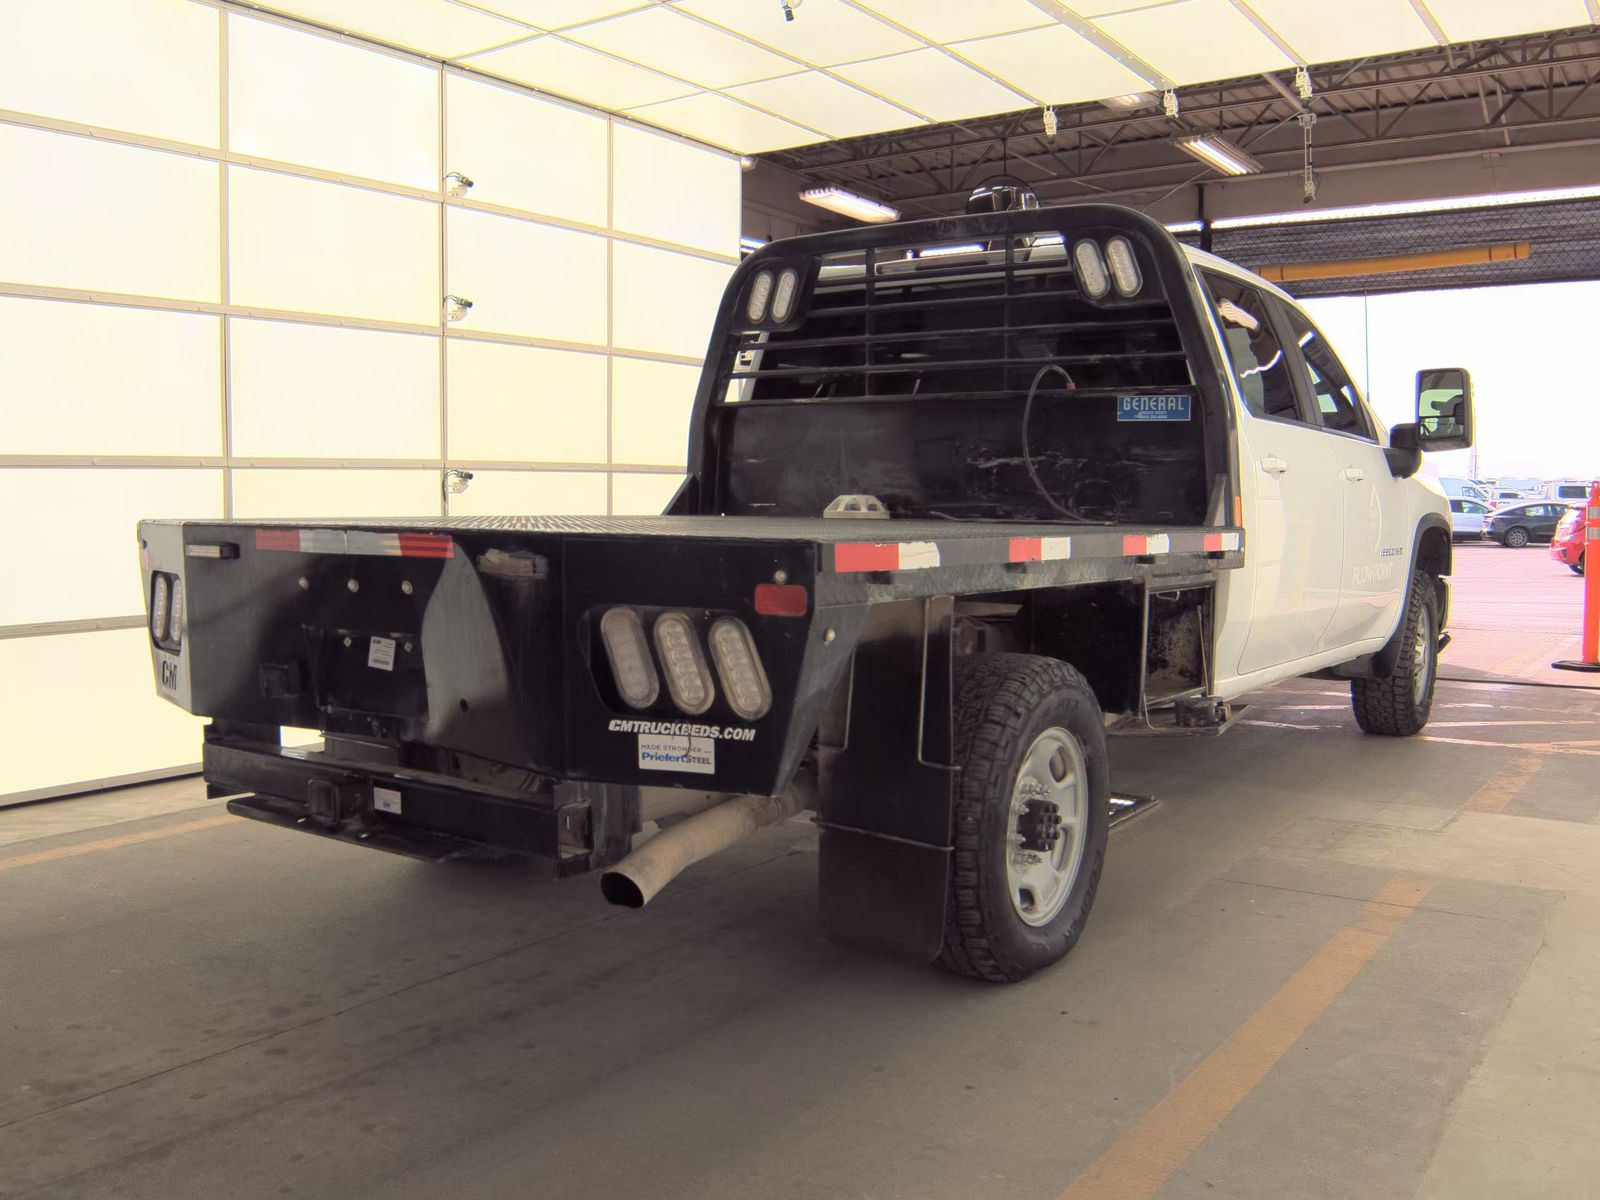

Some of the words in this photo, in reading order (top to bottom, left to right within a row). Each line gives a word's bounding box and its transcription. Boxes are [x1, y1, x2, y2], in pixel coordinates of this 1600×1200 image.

[1123, 397, 1185, 411] GENERAL
[161, 659, 178, 693] CM
[608, 719, 756, 742] CMTRUCKBEDS.COM
[662, 744, 702, 753] STRONER
